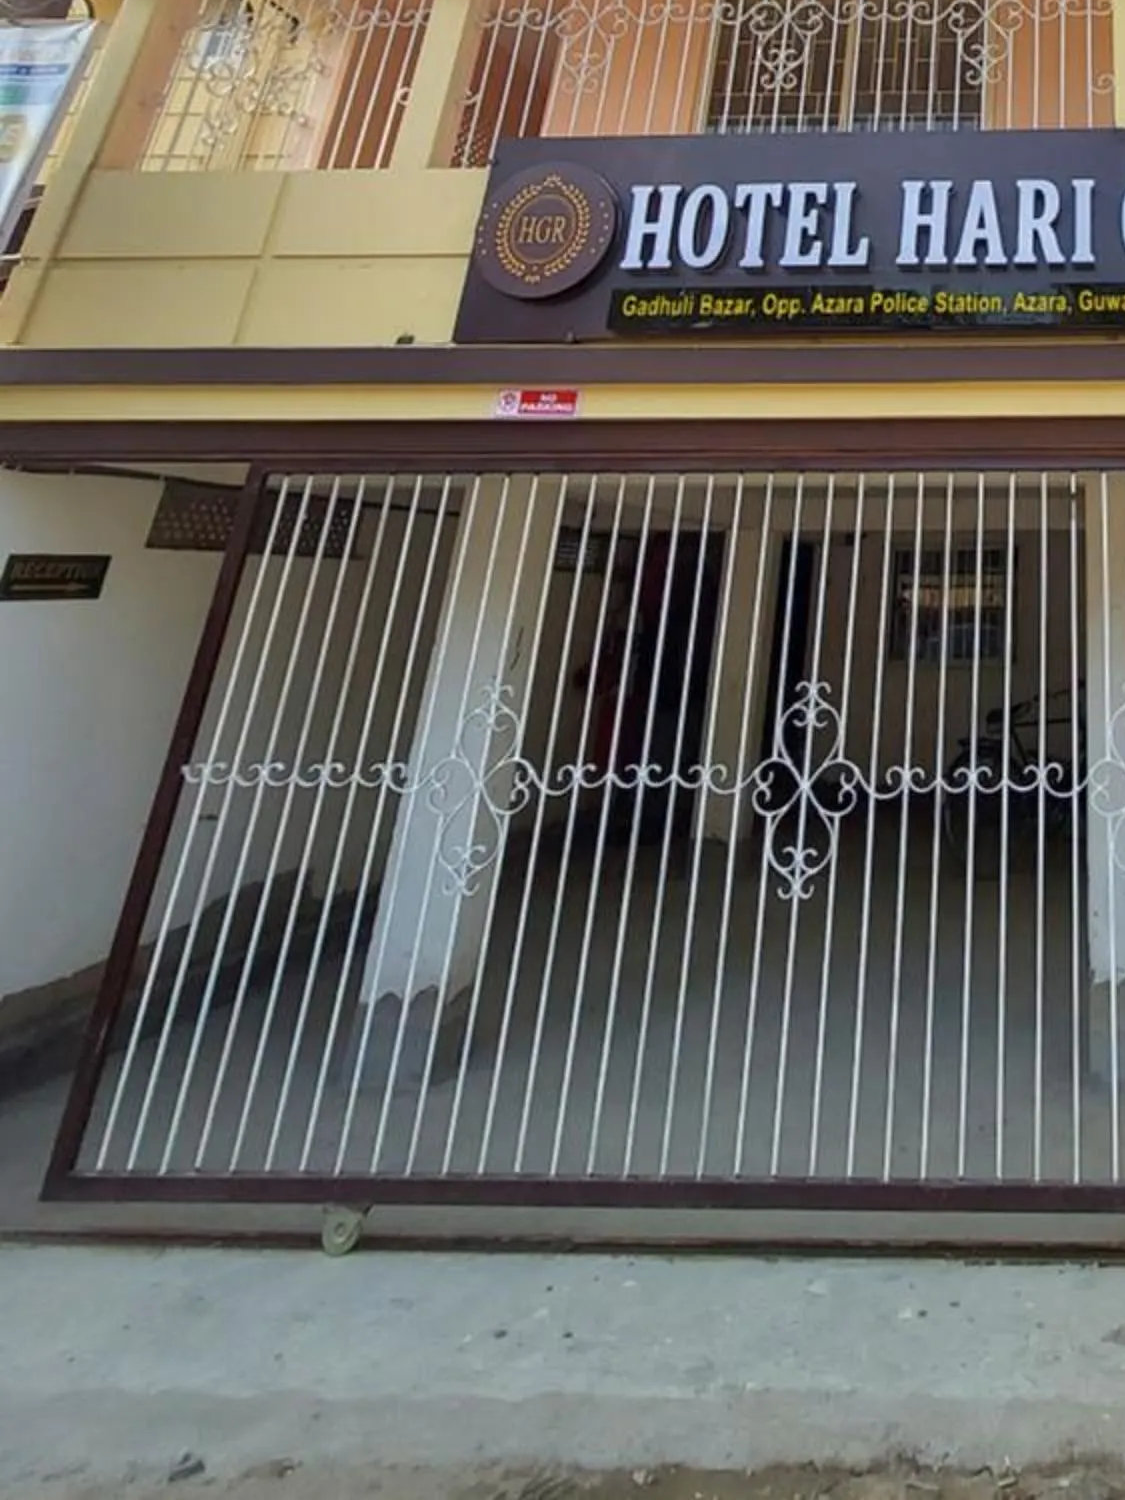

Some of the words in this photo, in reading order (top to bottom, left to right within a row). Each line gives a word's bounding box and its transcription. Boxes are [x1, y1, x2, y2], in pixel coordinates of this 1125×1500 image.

[518, 215, 567, 243] HGR
[620, 182, 870, 269] HOTEL
[896, 179, 1096, 265] HARI
[700, 293, 755, 318] Bazar,
[762, 294, 804, 319] Opp.
[811, 292, 864, 314] Azara
[870, 290, 928, 314] Police
[935, 291, 1006, 314] Station,
[1013, 290, 1072, 314] Azara,
